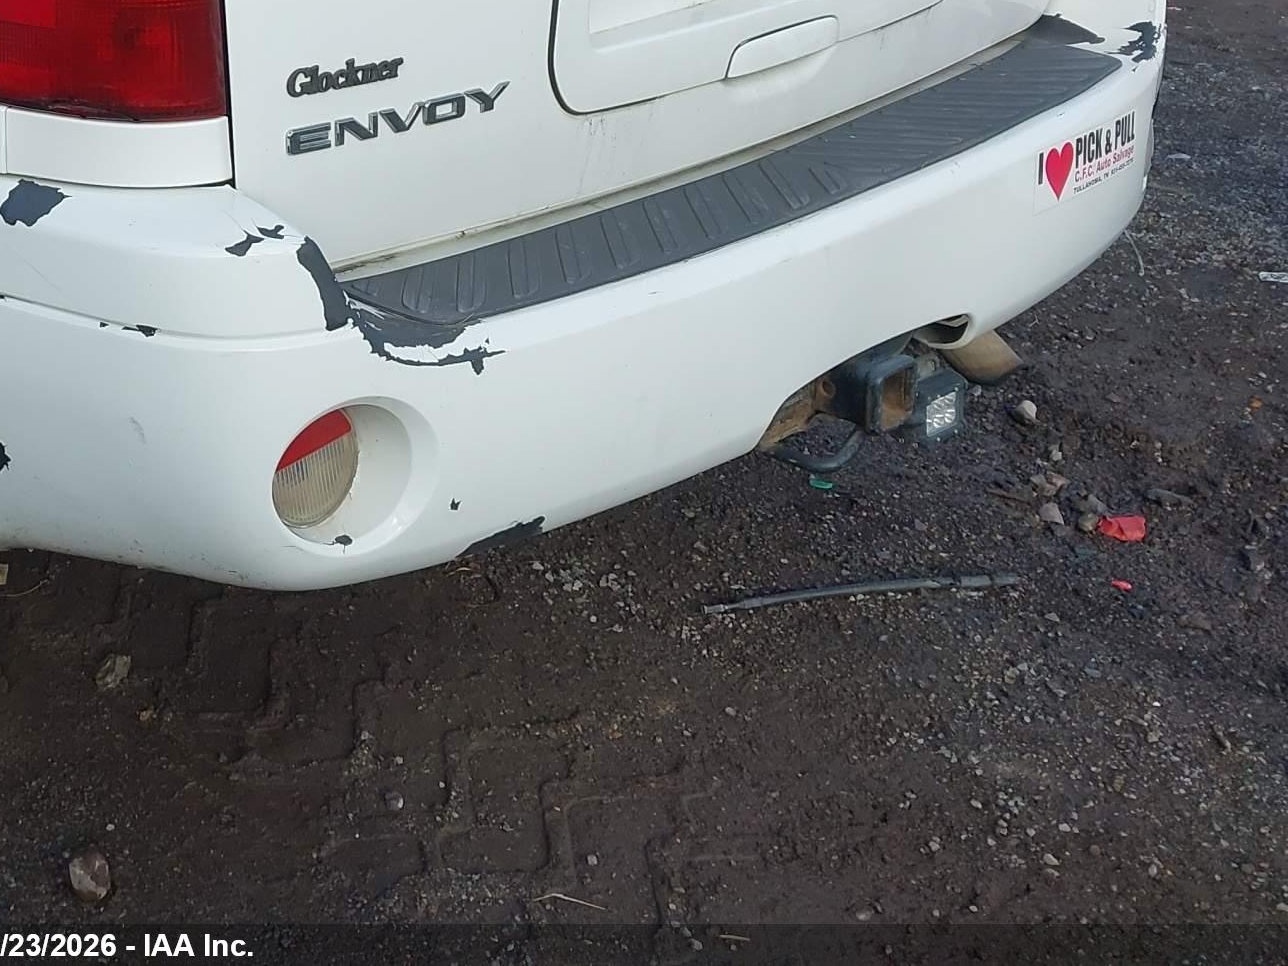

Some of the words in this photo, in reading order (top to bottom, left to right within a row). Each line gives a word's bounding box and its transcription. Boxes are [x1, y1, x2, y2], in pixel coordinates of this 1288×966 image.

[286, 56, 404, 98] Glockner
[286, 80, 510, 155] ENVOY
[1075, 128, 1103, 169] PICK
[1105, 129, 1113, 155] &
[1115, 111, 1135, 150] PULL
[1096, 157, 1112, 172] Auto
[1113, 145, 1135, 165] Salvage
